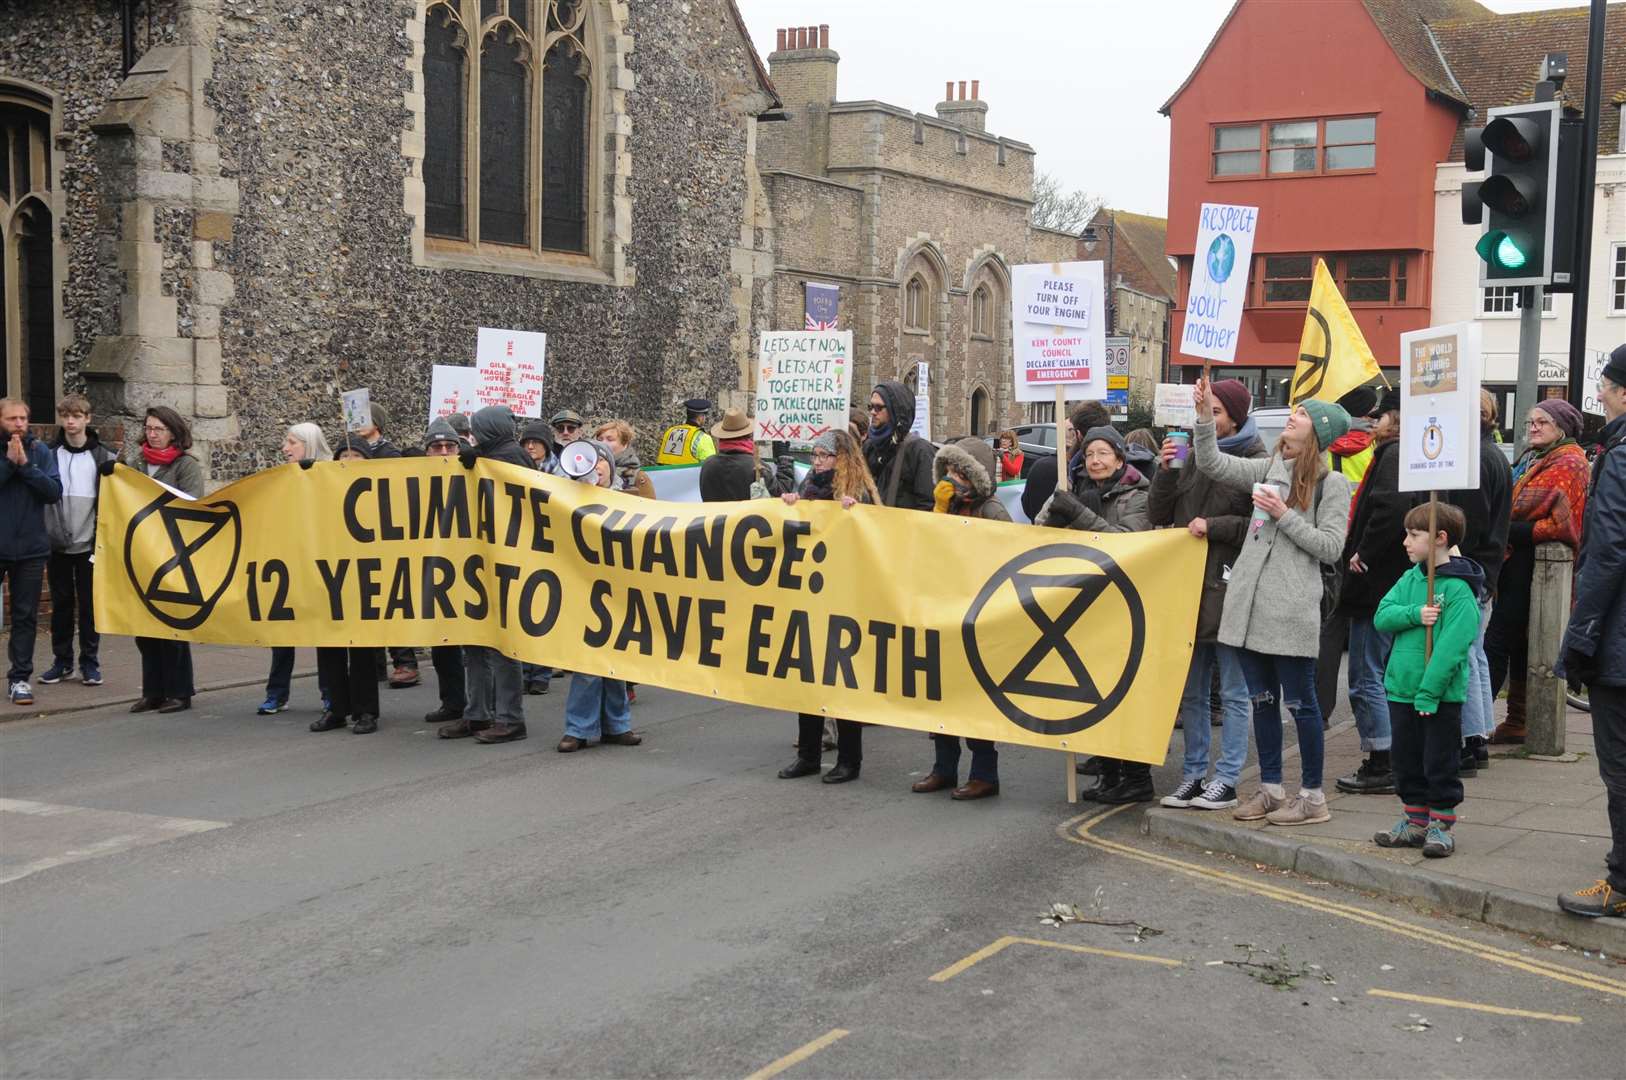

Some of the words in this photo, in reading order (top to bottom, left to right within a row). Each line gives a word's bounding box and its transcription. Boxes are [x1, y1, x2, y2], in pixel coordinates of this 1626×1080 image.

[1043, 280, 1074, 292] PLEASE
[1036, 293, 1058, 303] TURN
[1063, 295, 1079, 305] OFF
[1027, 305, 1050, 316] YOUR
[1055, 307, 1086, 320] ENGINE
[1185, 322, 1235, 349] mother
[791, 338, 816, 352] ACT
[819, 338, 845, 352] NOW
[1031, 340, 1049, 348] KENT
[1052, 338, 1082, 347] COUNTY
[1042, 349, 1072, 357] COUNCIL
[807, 360, 831, 374] ACT
[1026, 360, 1055, 369] DECLARE
[1060, 359, 1089, 367] CLIMATE
[1036, 370, 1079, 379] EMERGENCY
[768, 378, 834, 393] TOGETHER
[757, 399, 768, 411] TO
[771, 397, 805, 410] TACKLE
[807, 397, 845, 411] CLIMATE
[779, 413, 823, 424] CHANGE
[344, 475, 554, 553] CLIMATE
[571, 511, 826, 593] CHANGE:
[246, 559, 295, 621] 12
[316, 555, 488, 620] YEARS
[495, 563, 561, 637] TO
[584, 580, 725, 667] SAVE
[746, 605, 941, 701] EARTH
